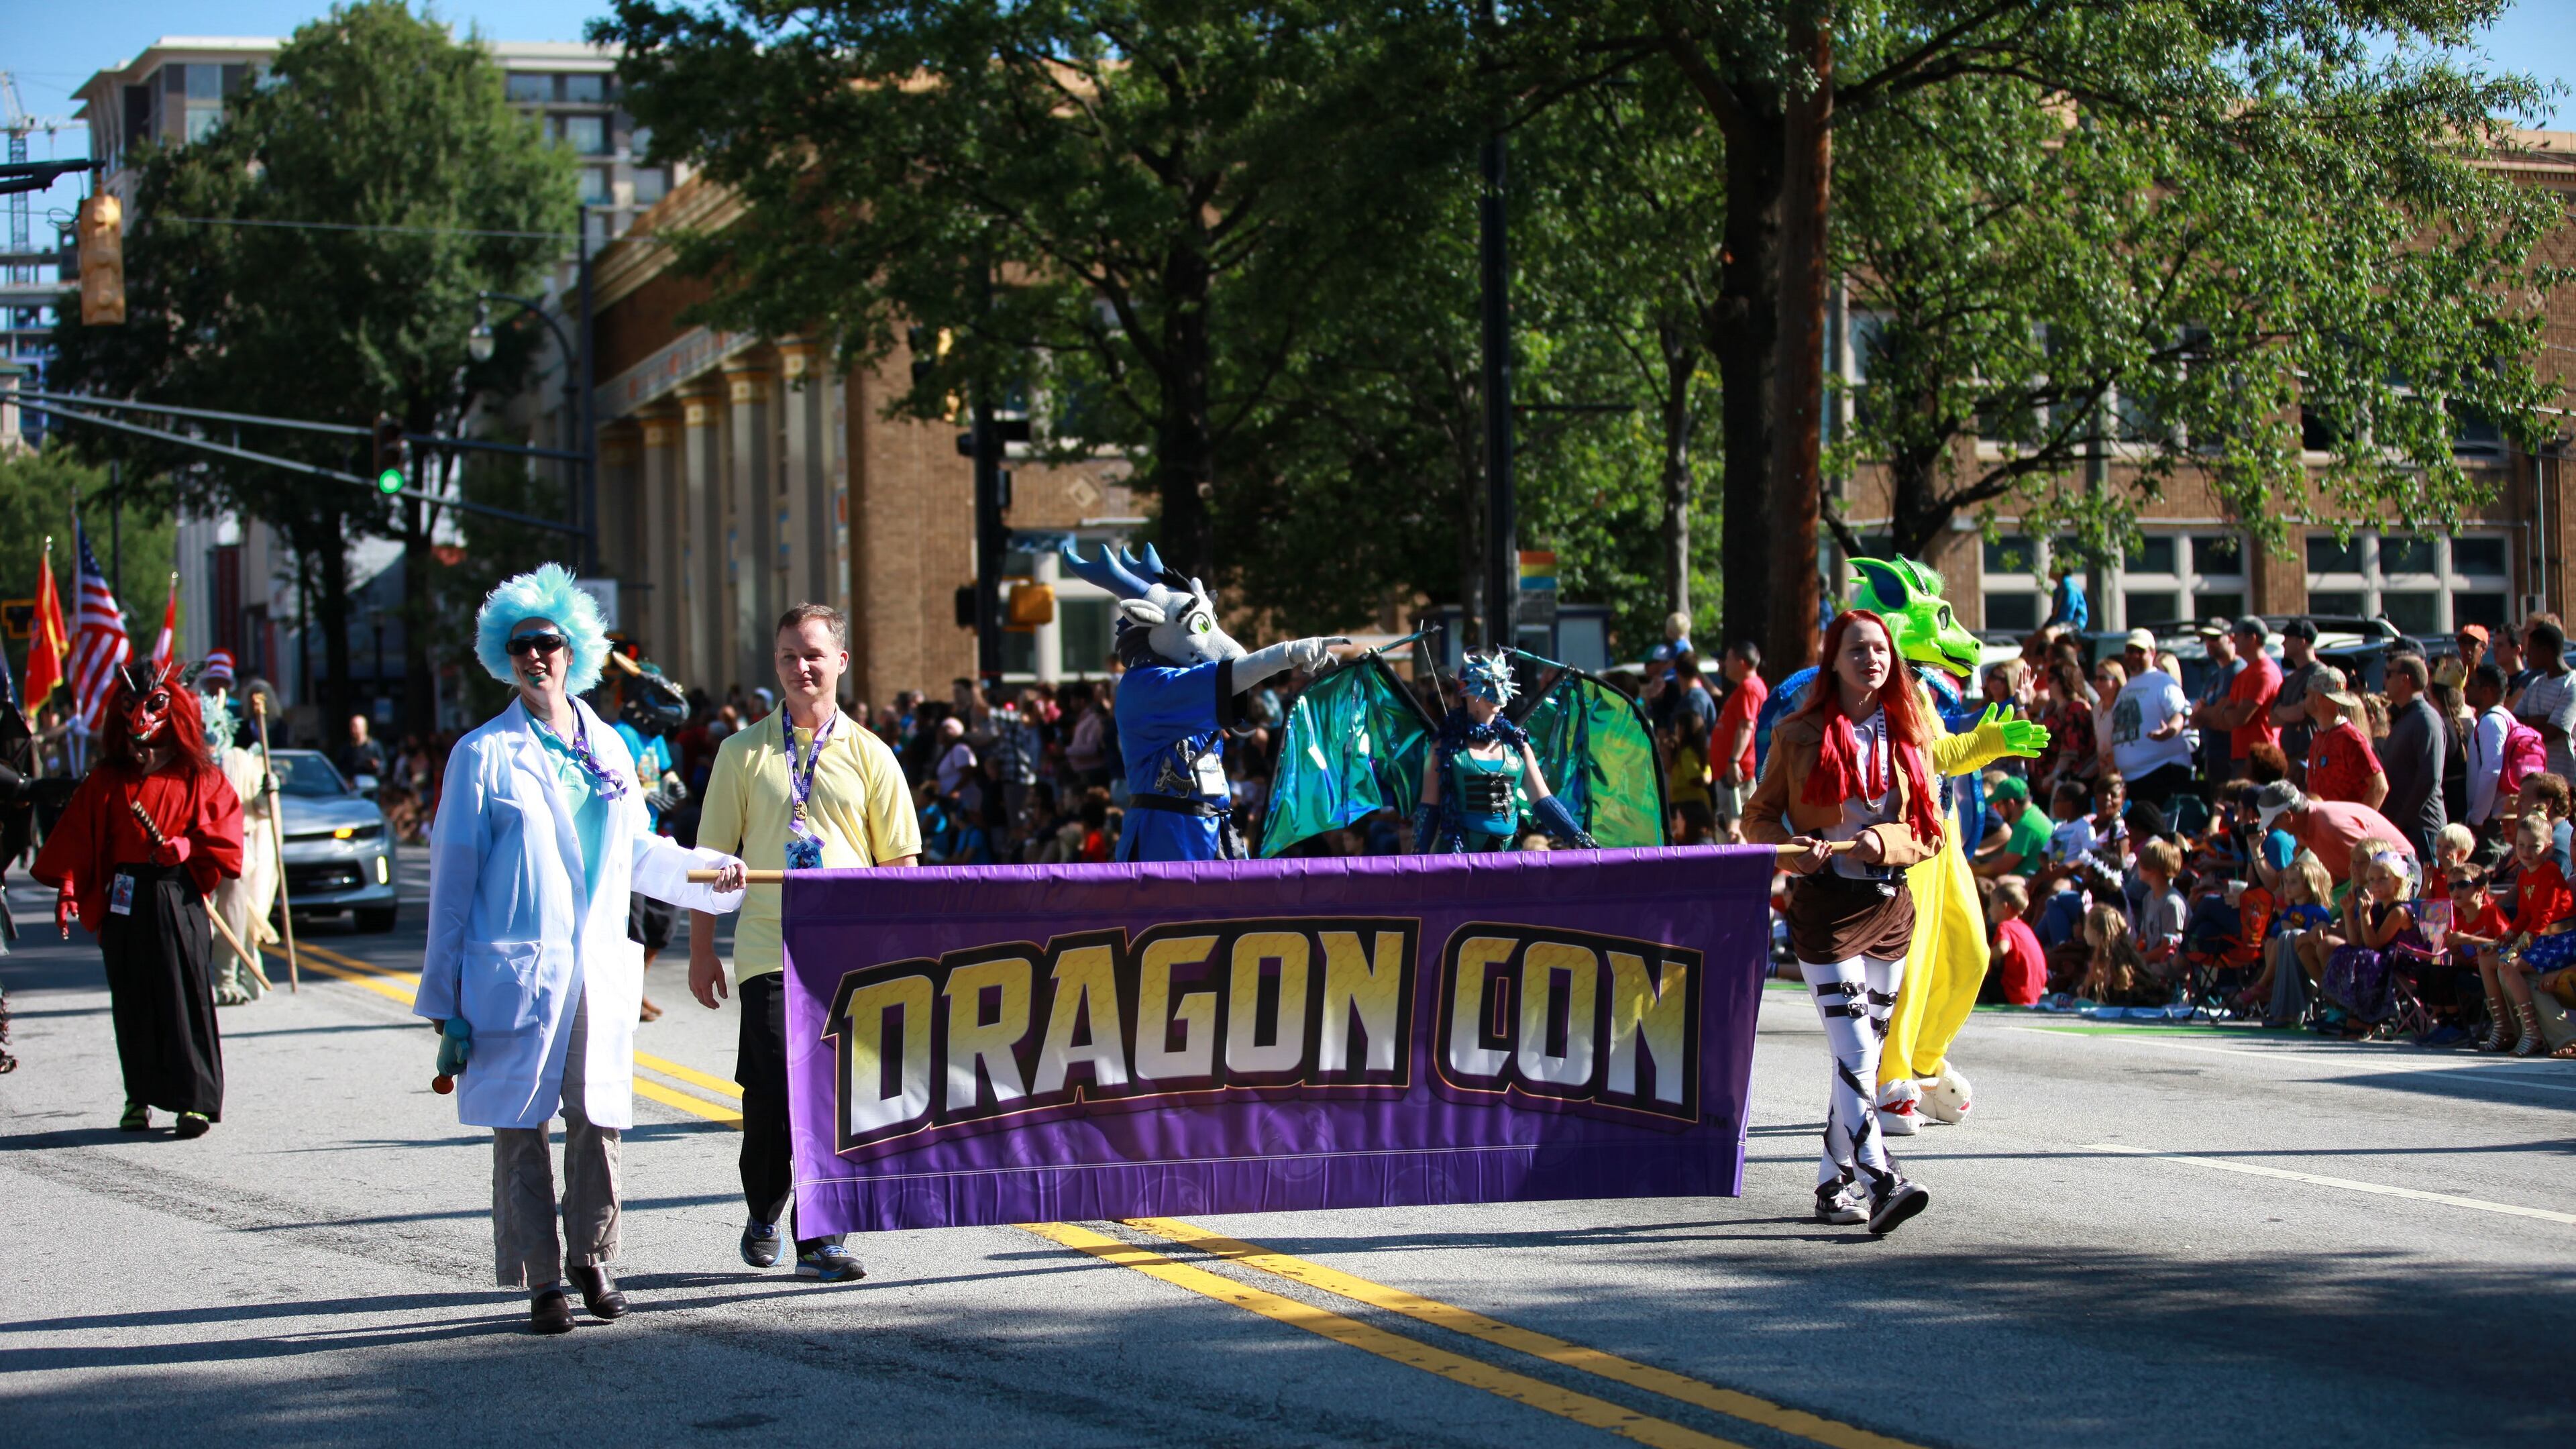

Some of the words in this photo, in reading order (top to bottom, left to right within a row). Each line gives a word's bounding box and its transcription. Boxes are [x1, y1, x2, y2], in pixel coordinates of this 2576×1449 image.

[809, 743, 818, 761] VOLUNTEER
[844, 930, 1405, 1136] DRAGON
[1449, 936, 1688, 1106] CON
[1705, 1114, 1728, 1129] TM
